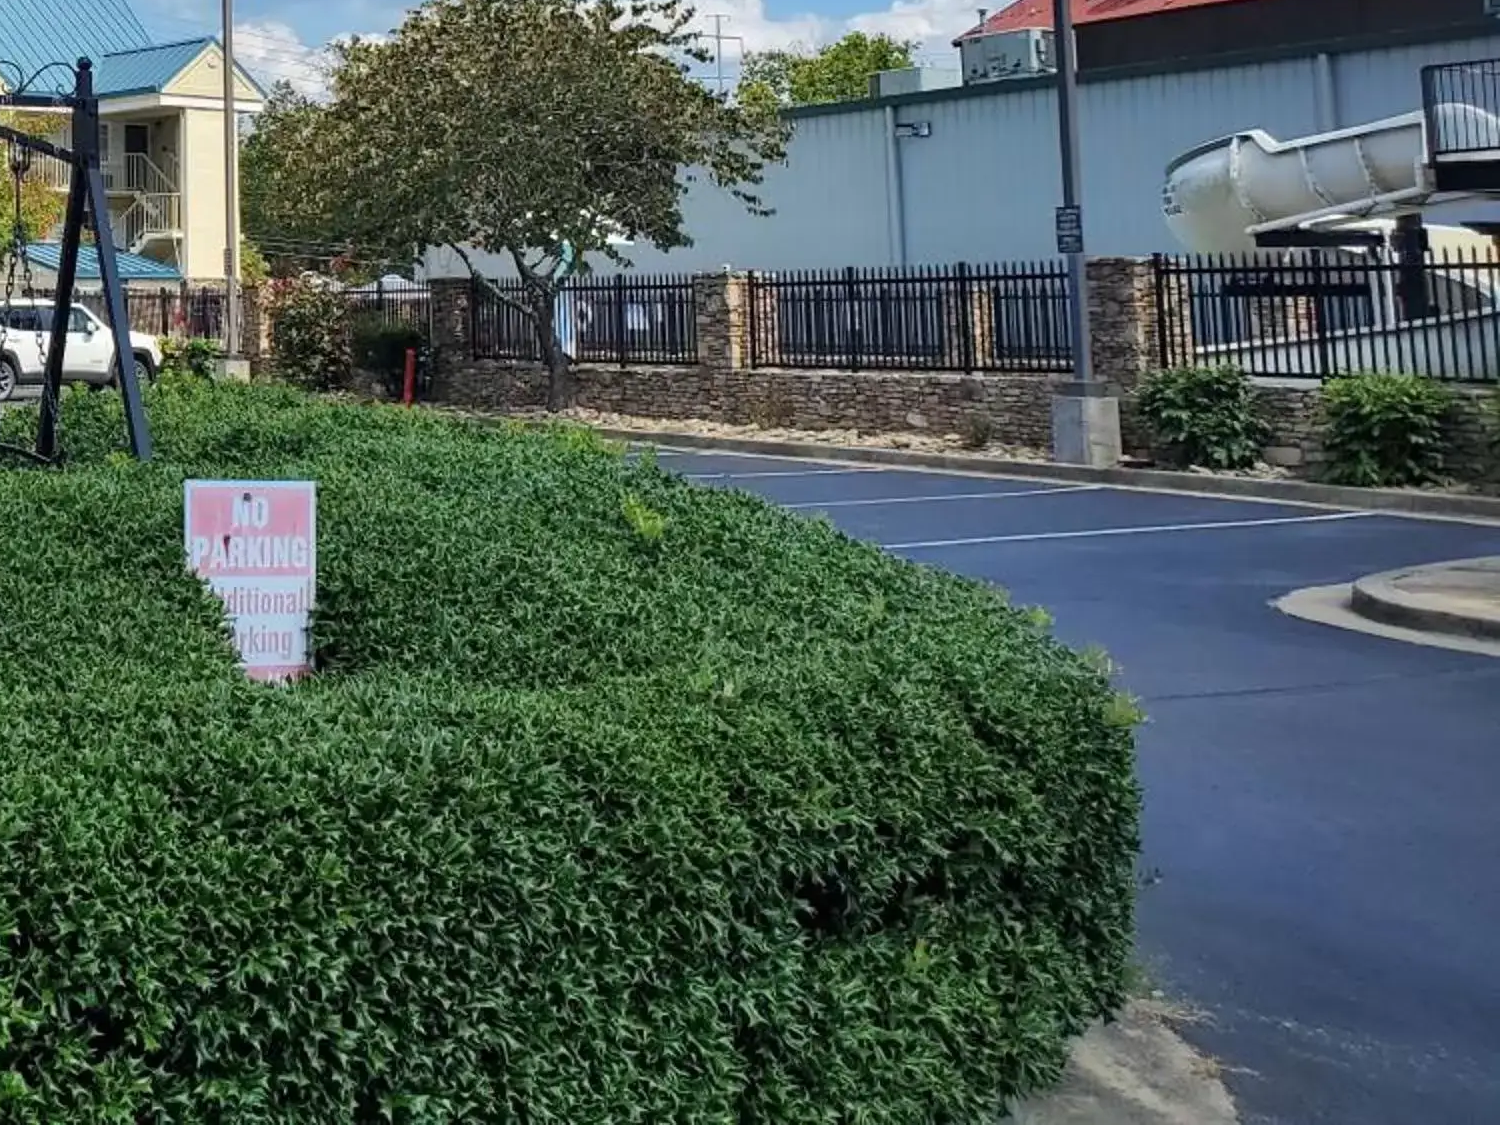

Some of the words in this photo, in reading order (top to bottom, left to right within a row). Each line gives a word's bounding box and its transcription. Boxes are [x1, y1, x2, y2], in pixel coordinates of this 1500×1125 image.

[232, 496, 270, 528] NO
[191, 534, 308, 568] PARKING
[222, 586, 304, 615] ditional
[234, 624, 293, 660] rking
